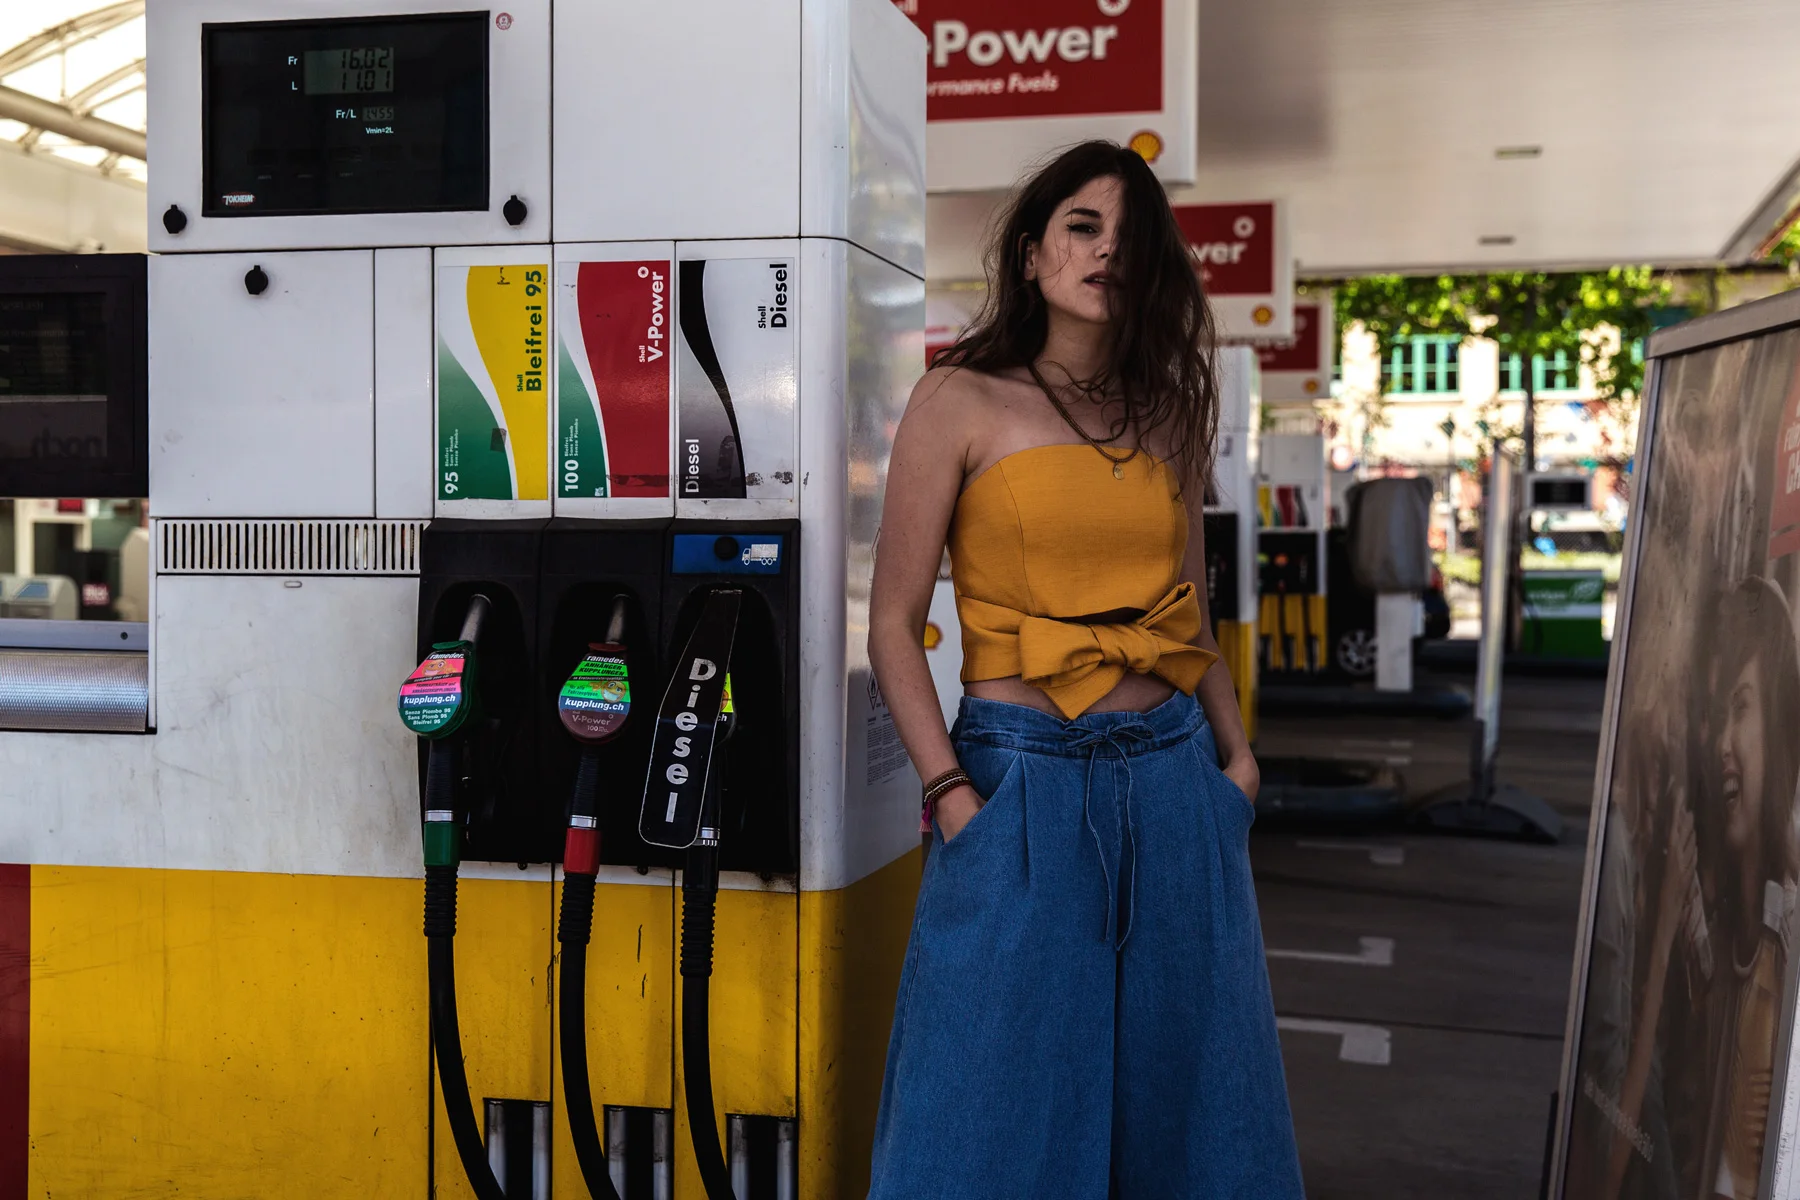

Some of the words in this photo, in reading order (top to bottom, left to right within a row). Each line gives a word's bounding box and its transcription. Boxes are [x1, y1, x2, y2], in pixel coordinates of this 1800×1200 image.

[287, 56, 299, 66] Fr
[341, 48, 390, 70] 16.02
[291, 81, 298, 91] L
[342, 70, 391, 91] 11.01
[1007, 69, 1060, 94] Fuels
[335, 108, 357, 119] Fr/L
[222, 194, 255, 206] TOKHEIM
[525, 270, 542, 297] 95
[770, 263, 788, 328] Diesel
[648, 271, 664, 362] V-Power
[758, 305, 766, 329] Shell
[525, 305, 542, 391] Bleifrei
[564, 459, 579, 492] 100
[685, 438, 700, 494] Diesel
[444, 471, 459, 494] 95
[584, 662, 622, 670] ANHÄNGER
[587, 655, 624, 664] rameder.
[579, 667, 624, 676] KUPPLUNGEN
[404, 695, 456, 705] kupplung.ch
[565, 698, 625, 711] kupplung.ch
[572, 714, 611, 725] V-Power
[666, 657, 717, 823] Diesel
